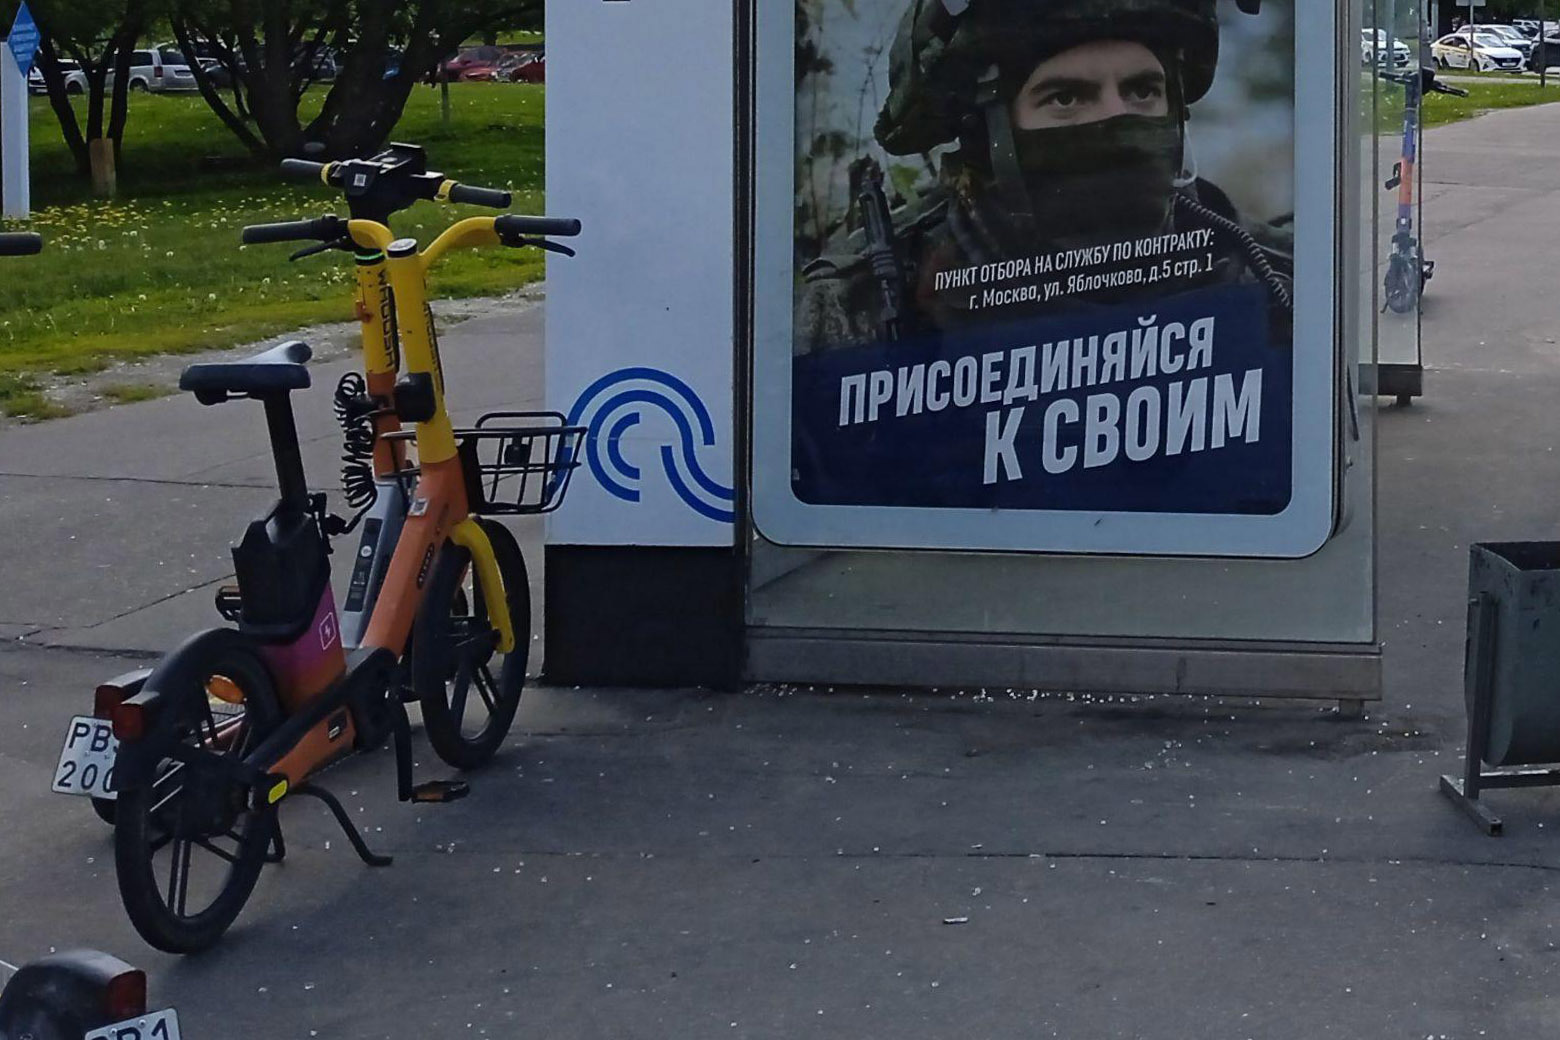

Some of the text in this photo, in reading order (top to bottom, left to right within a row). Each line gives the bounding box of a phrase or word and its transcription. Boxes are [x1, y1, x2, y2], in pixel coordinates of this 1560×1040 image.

[935, 227, 1215, 291] ПУНКТ ОТБОРА НА СЛУЖБУ ПО КОНТРАКТУ:
[969, 252, 1214, 310] г. Москва, ул. Яблочкова, д.5 стр. 1
[839, 313, 1216, 427] ПРИСОЕДИНЯЙСЯ
[982, 368, 1264, 486] К СВОИМ
[68, 722, 119, 753] PB
